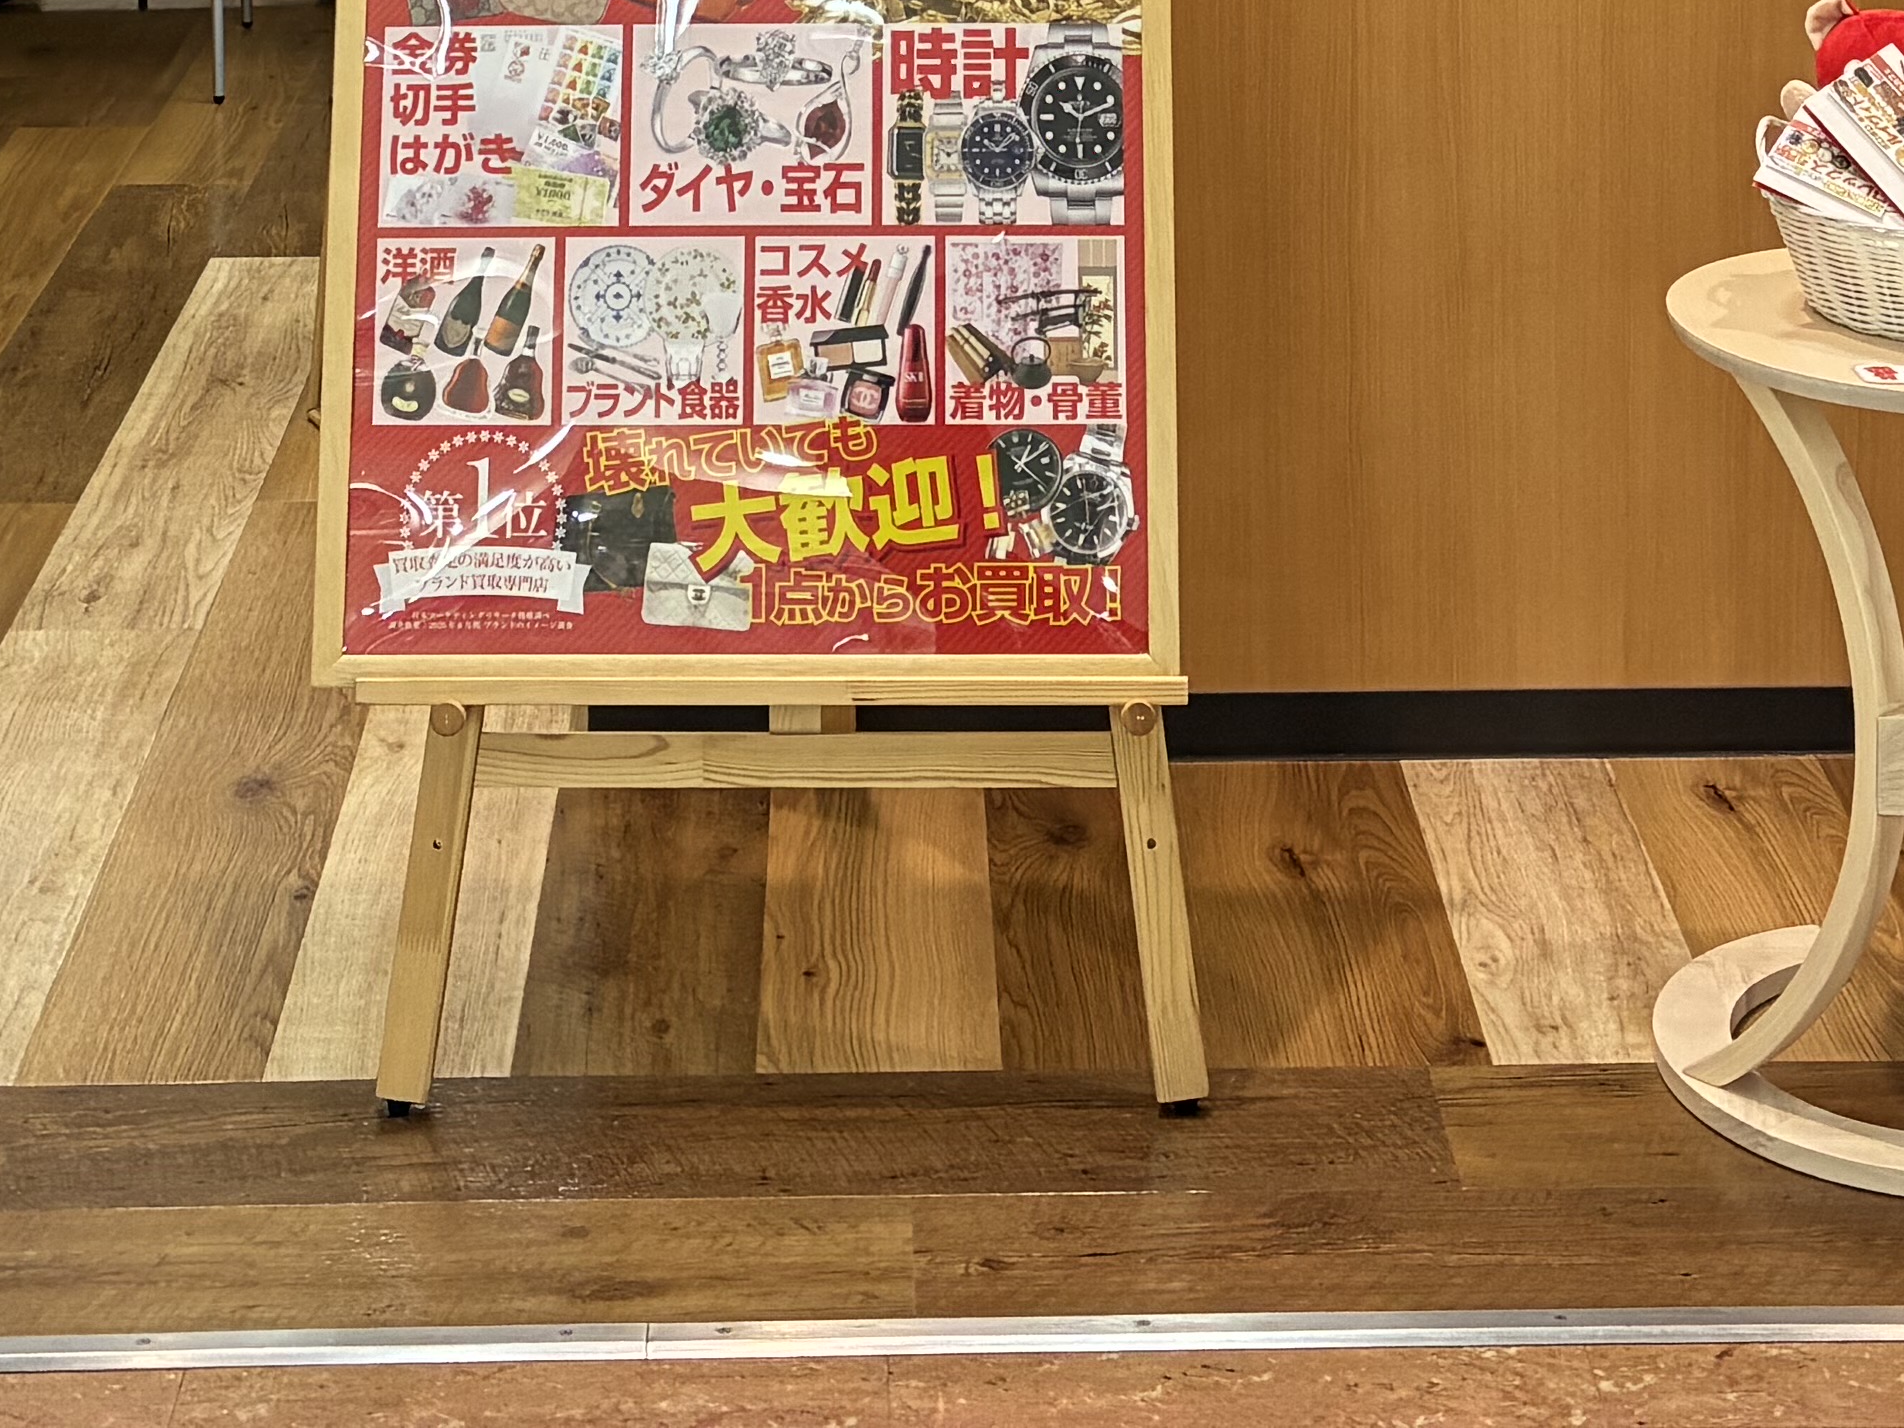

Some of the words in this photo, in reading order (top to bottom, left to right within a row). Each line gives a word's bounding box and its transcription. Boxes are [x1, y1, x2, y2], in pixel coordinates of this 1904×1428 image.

[391, 31, 478, 76] 金券
[890, 27, 1030, 100] 時計
[390, 82, 476, 127] 切手
[390, 132, 524, 176] はがき
[640, 161, 864, 216] ダイヤ・宝石
[381, 246, 457, 284] 洋酒
[759, 243, 868, 277] コスメ
[756, 284, 833, 325] 香水
[567, 378, 741, 421] ブランド食器
[950, 381, 1123, 421] 着物・骨董
[584, 414, 878, 495] 壊れていても
[691, 453, 1005, 572] 大歓迎！
